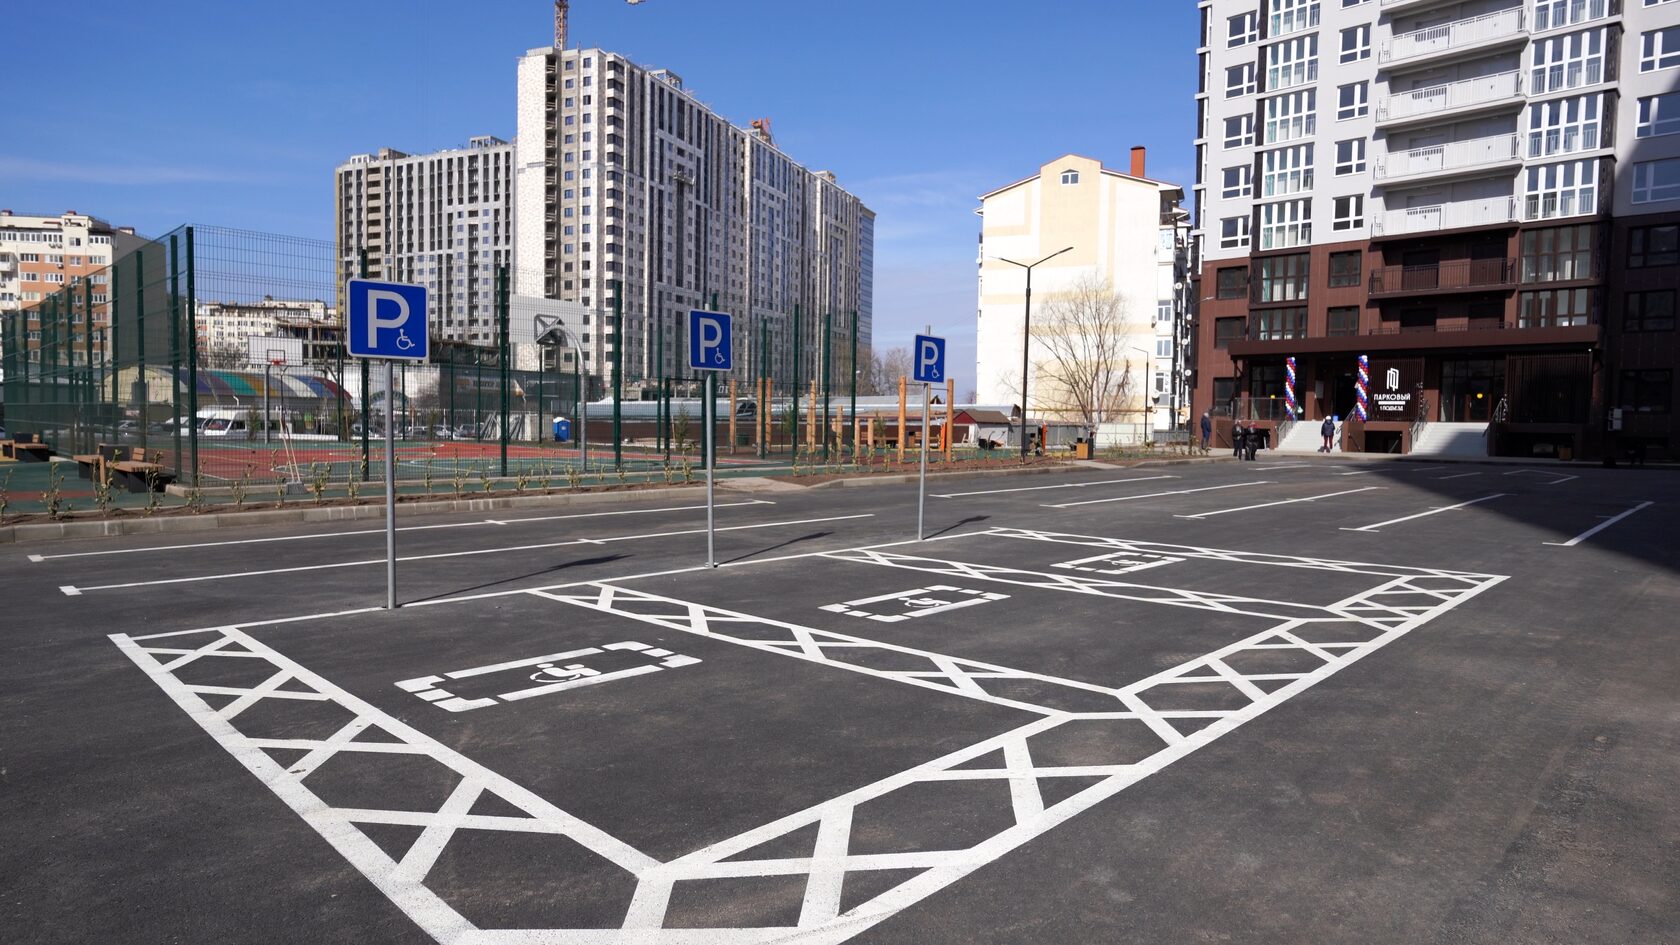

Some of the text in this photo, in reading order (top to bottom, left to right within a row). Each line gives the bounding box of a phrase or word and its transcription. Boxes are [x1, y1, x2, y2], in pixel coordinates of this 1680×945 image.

[368, 289, 410, 348] P
[699, 317, 722, 363] P
[920, 340, 939, 377] P
[1373, 393, 1411, 401] ПАРКОВЫЙ
